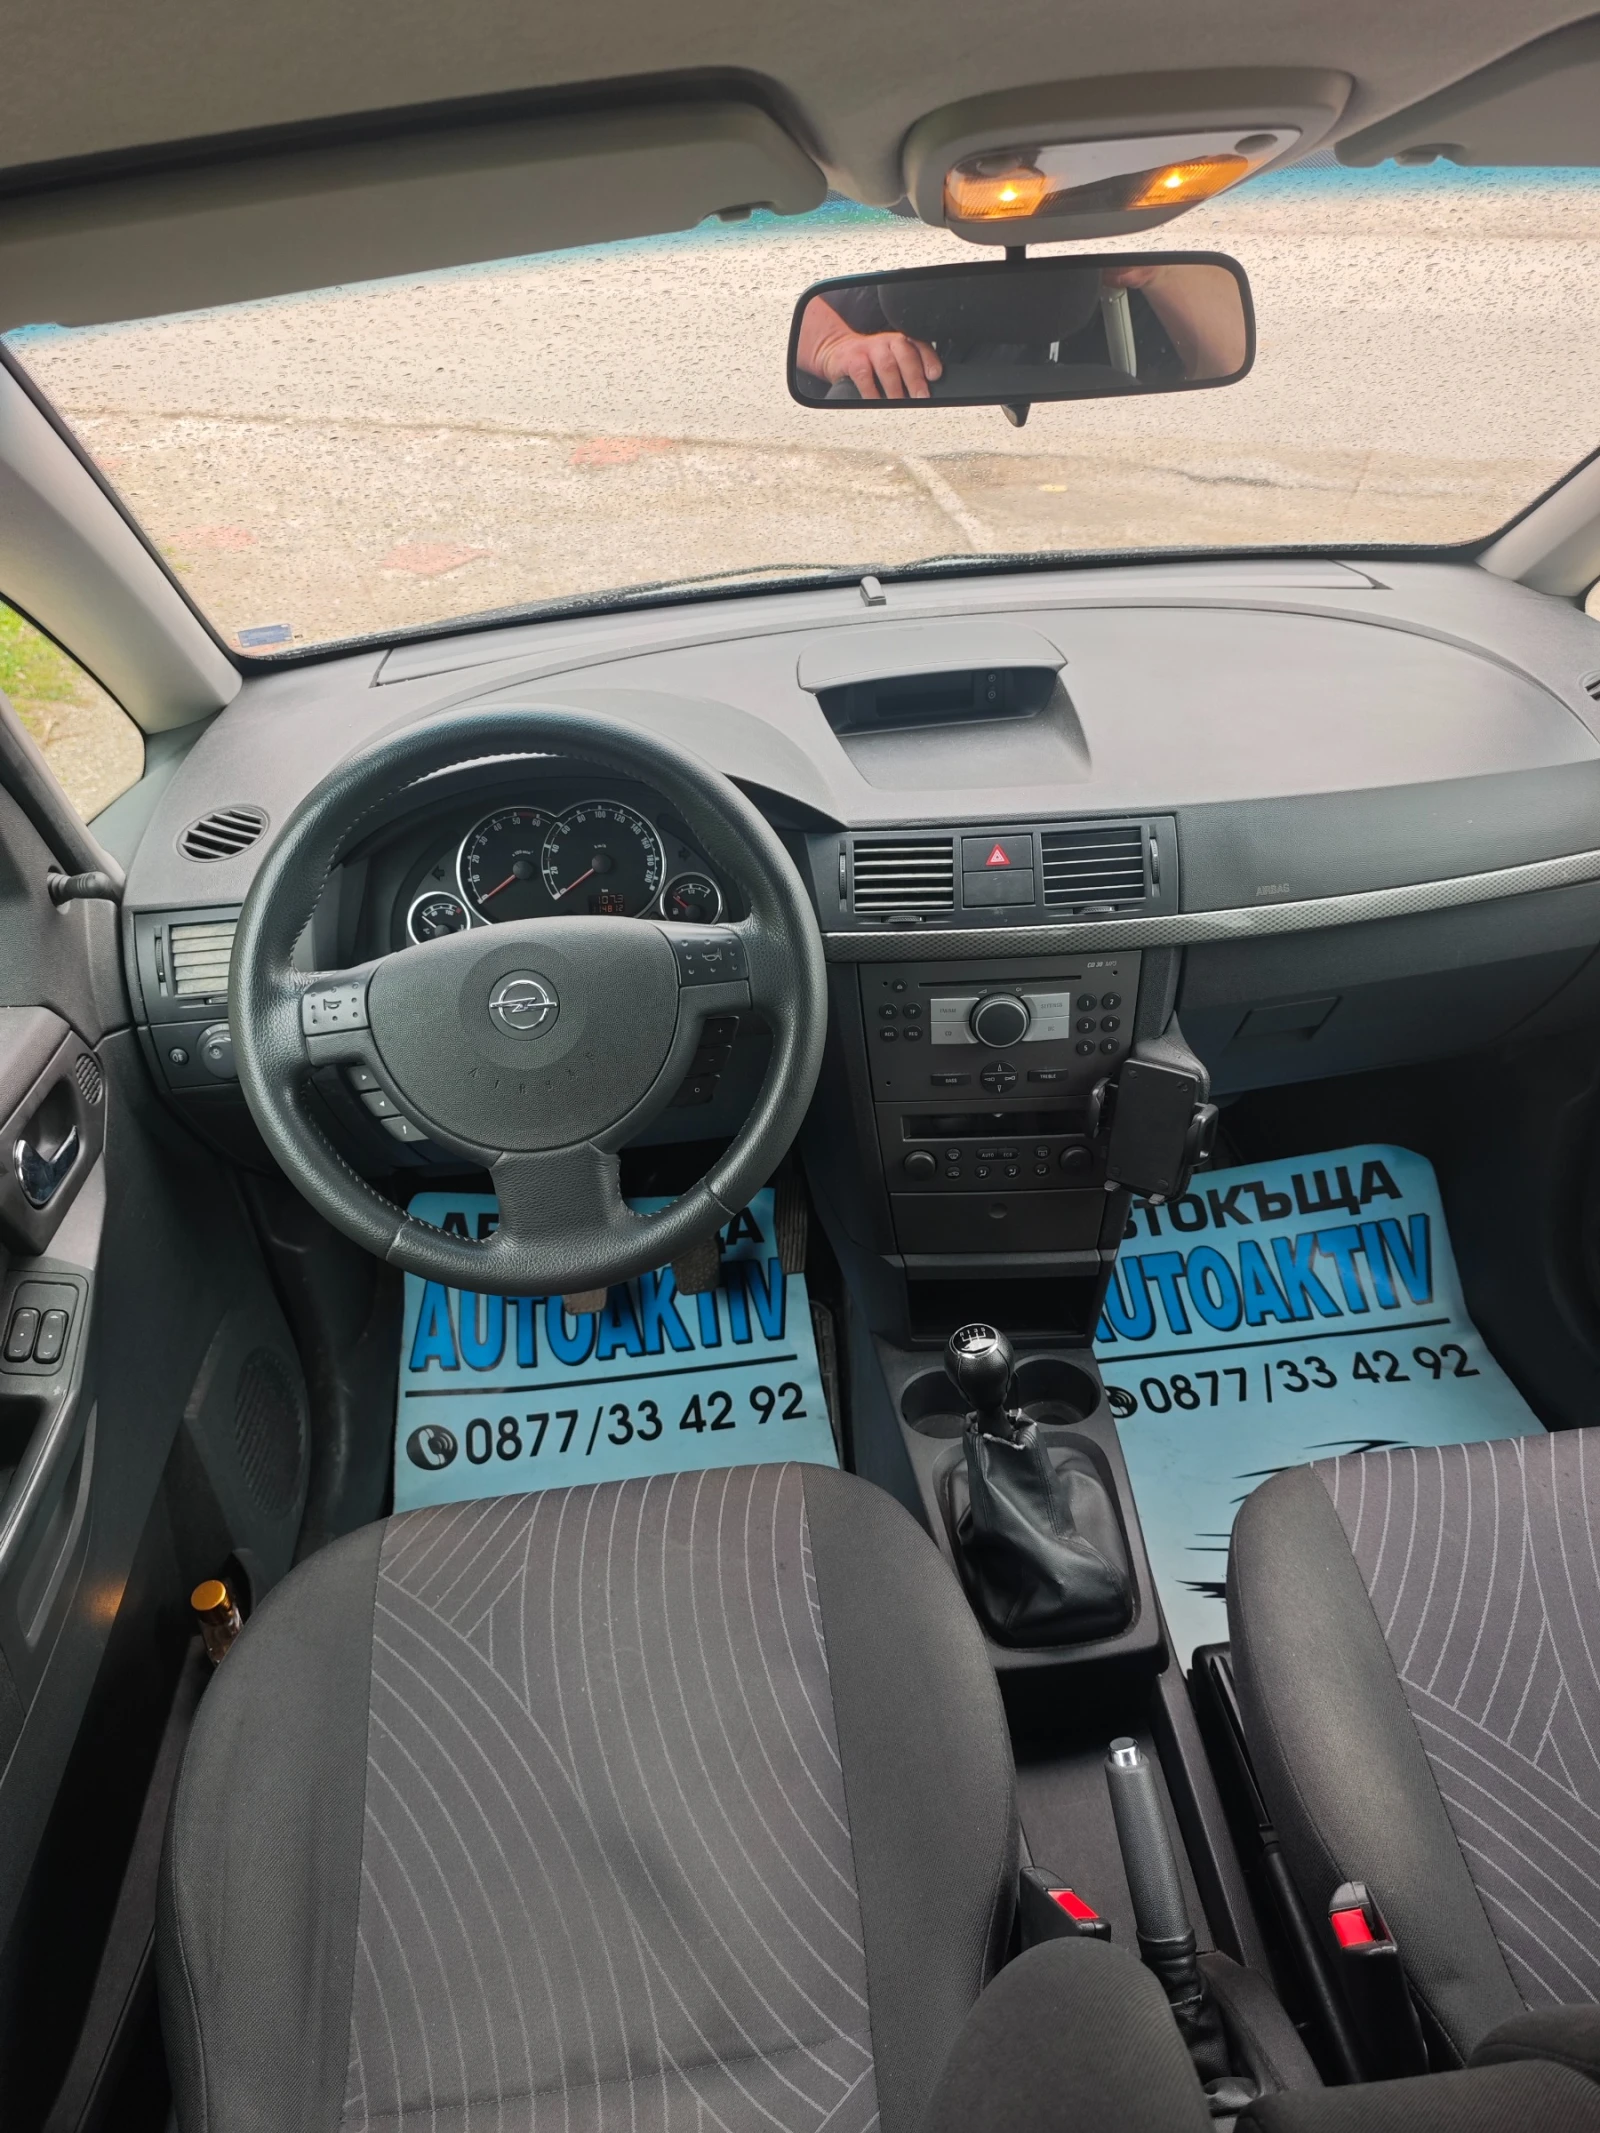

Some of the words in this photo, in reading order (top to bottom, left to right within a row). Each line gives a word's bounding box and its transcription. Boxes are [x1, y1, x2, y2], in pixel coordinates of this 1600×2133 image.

[576, 814, 586, 823] 80
[594, 811, 607, 819] 100
[613, 813, 626, 823] 120
[512, 817, 521, 825] 50
[532, 818, 541, 827] 60
[493, 823, 503, 832] 40
[561, 825, 571, 835] 60
[630, 823, 642, 835] 140
[479, 836, 488, 846] 30
[640, 837, 651, 849] 160
[551, 844, 560, 854] 40
[472, 854, 480, 864] 20
[646, 854, 654, 866] 180
[551, 866, 559, 875] 20
[472, 874, 480, 882] 10
[644, 870, 653, 883] 200
[1122, 1160, 1402, 1240] ТОКЪЩА
[1353, 1350, 1410, 1383] 42
[1413, 1344, 1480, 1379] 92
[679, 1391, 736, 1433] 42
[750, 1382, 807, 1424] 92
